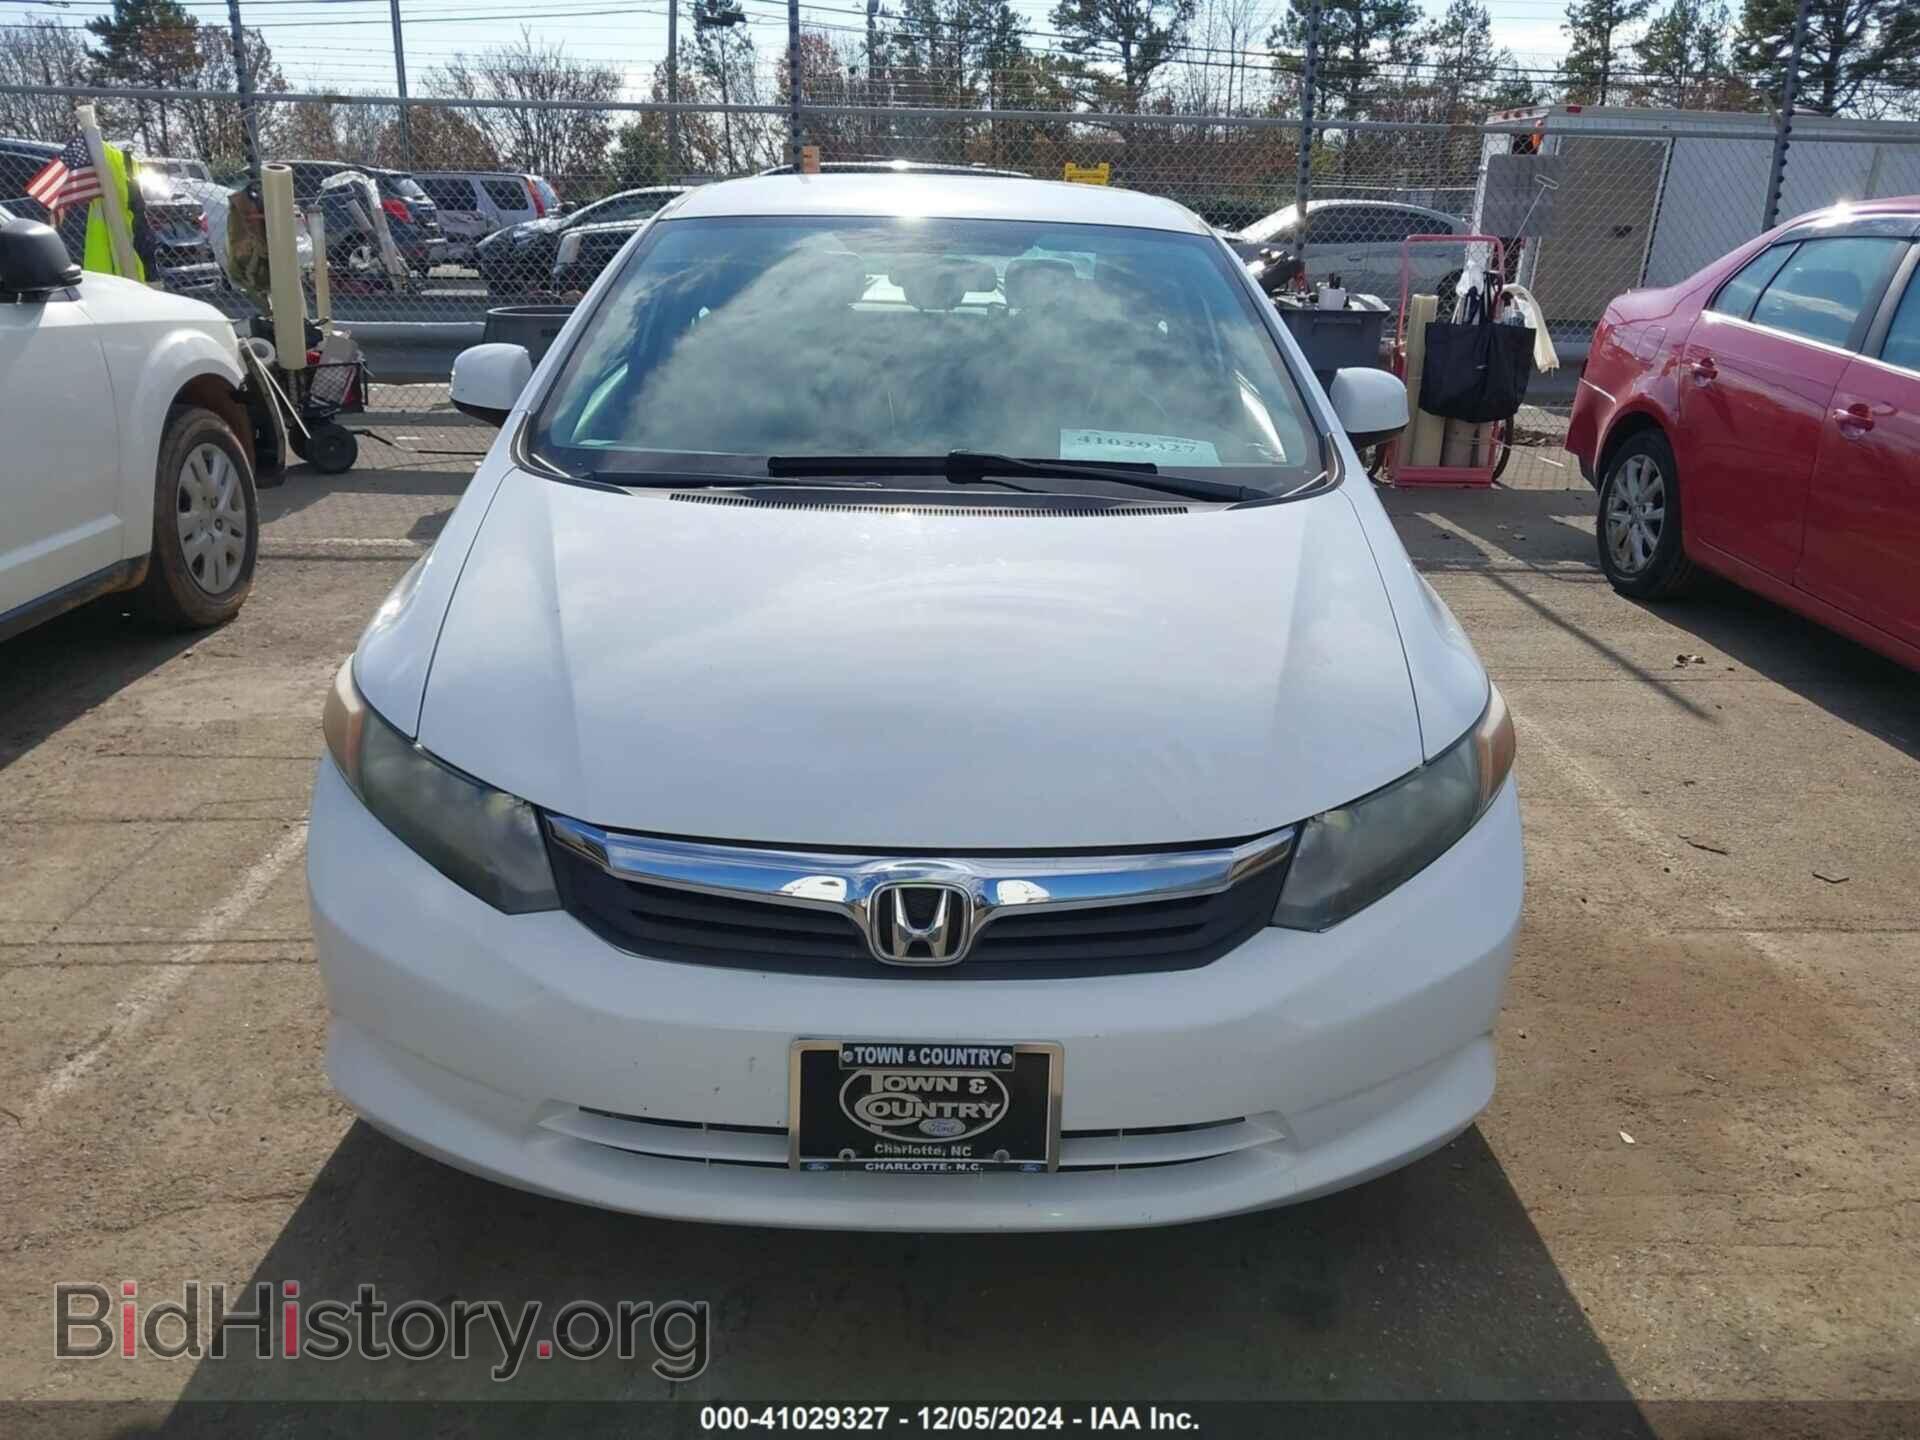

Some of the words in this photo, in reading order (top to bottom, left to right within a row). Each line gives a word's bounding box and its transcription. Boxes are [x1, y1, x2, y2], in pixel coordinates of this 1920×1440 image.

[854, 1047, 904, 1065] TOWN
[919, 1048, 1002, 1067] COUNTRY
[968, 1078, 988, 1094] &
[854, 1092, 1001, 1126] COUNTRY
[874, 1143, 946, 1157] Charlotte,
[951, 1147, 972, 1157] NC
[956, 1163, 984, 1171] N.C.
